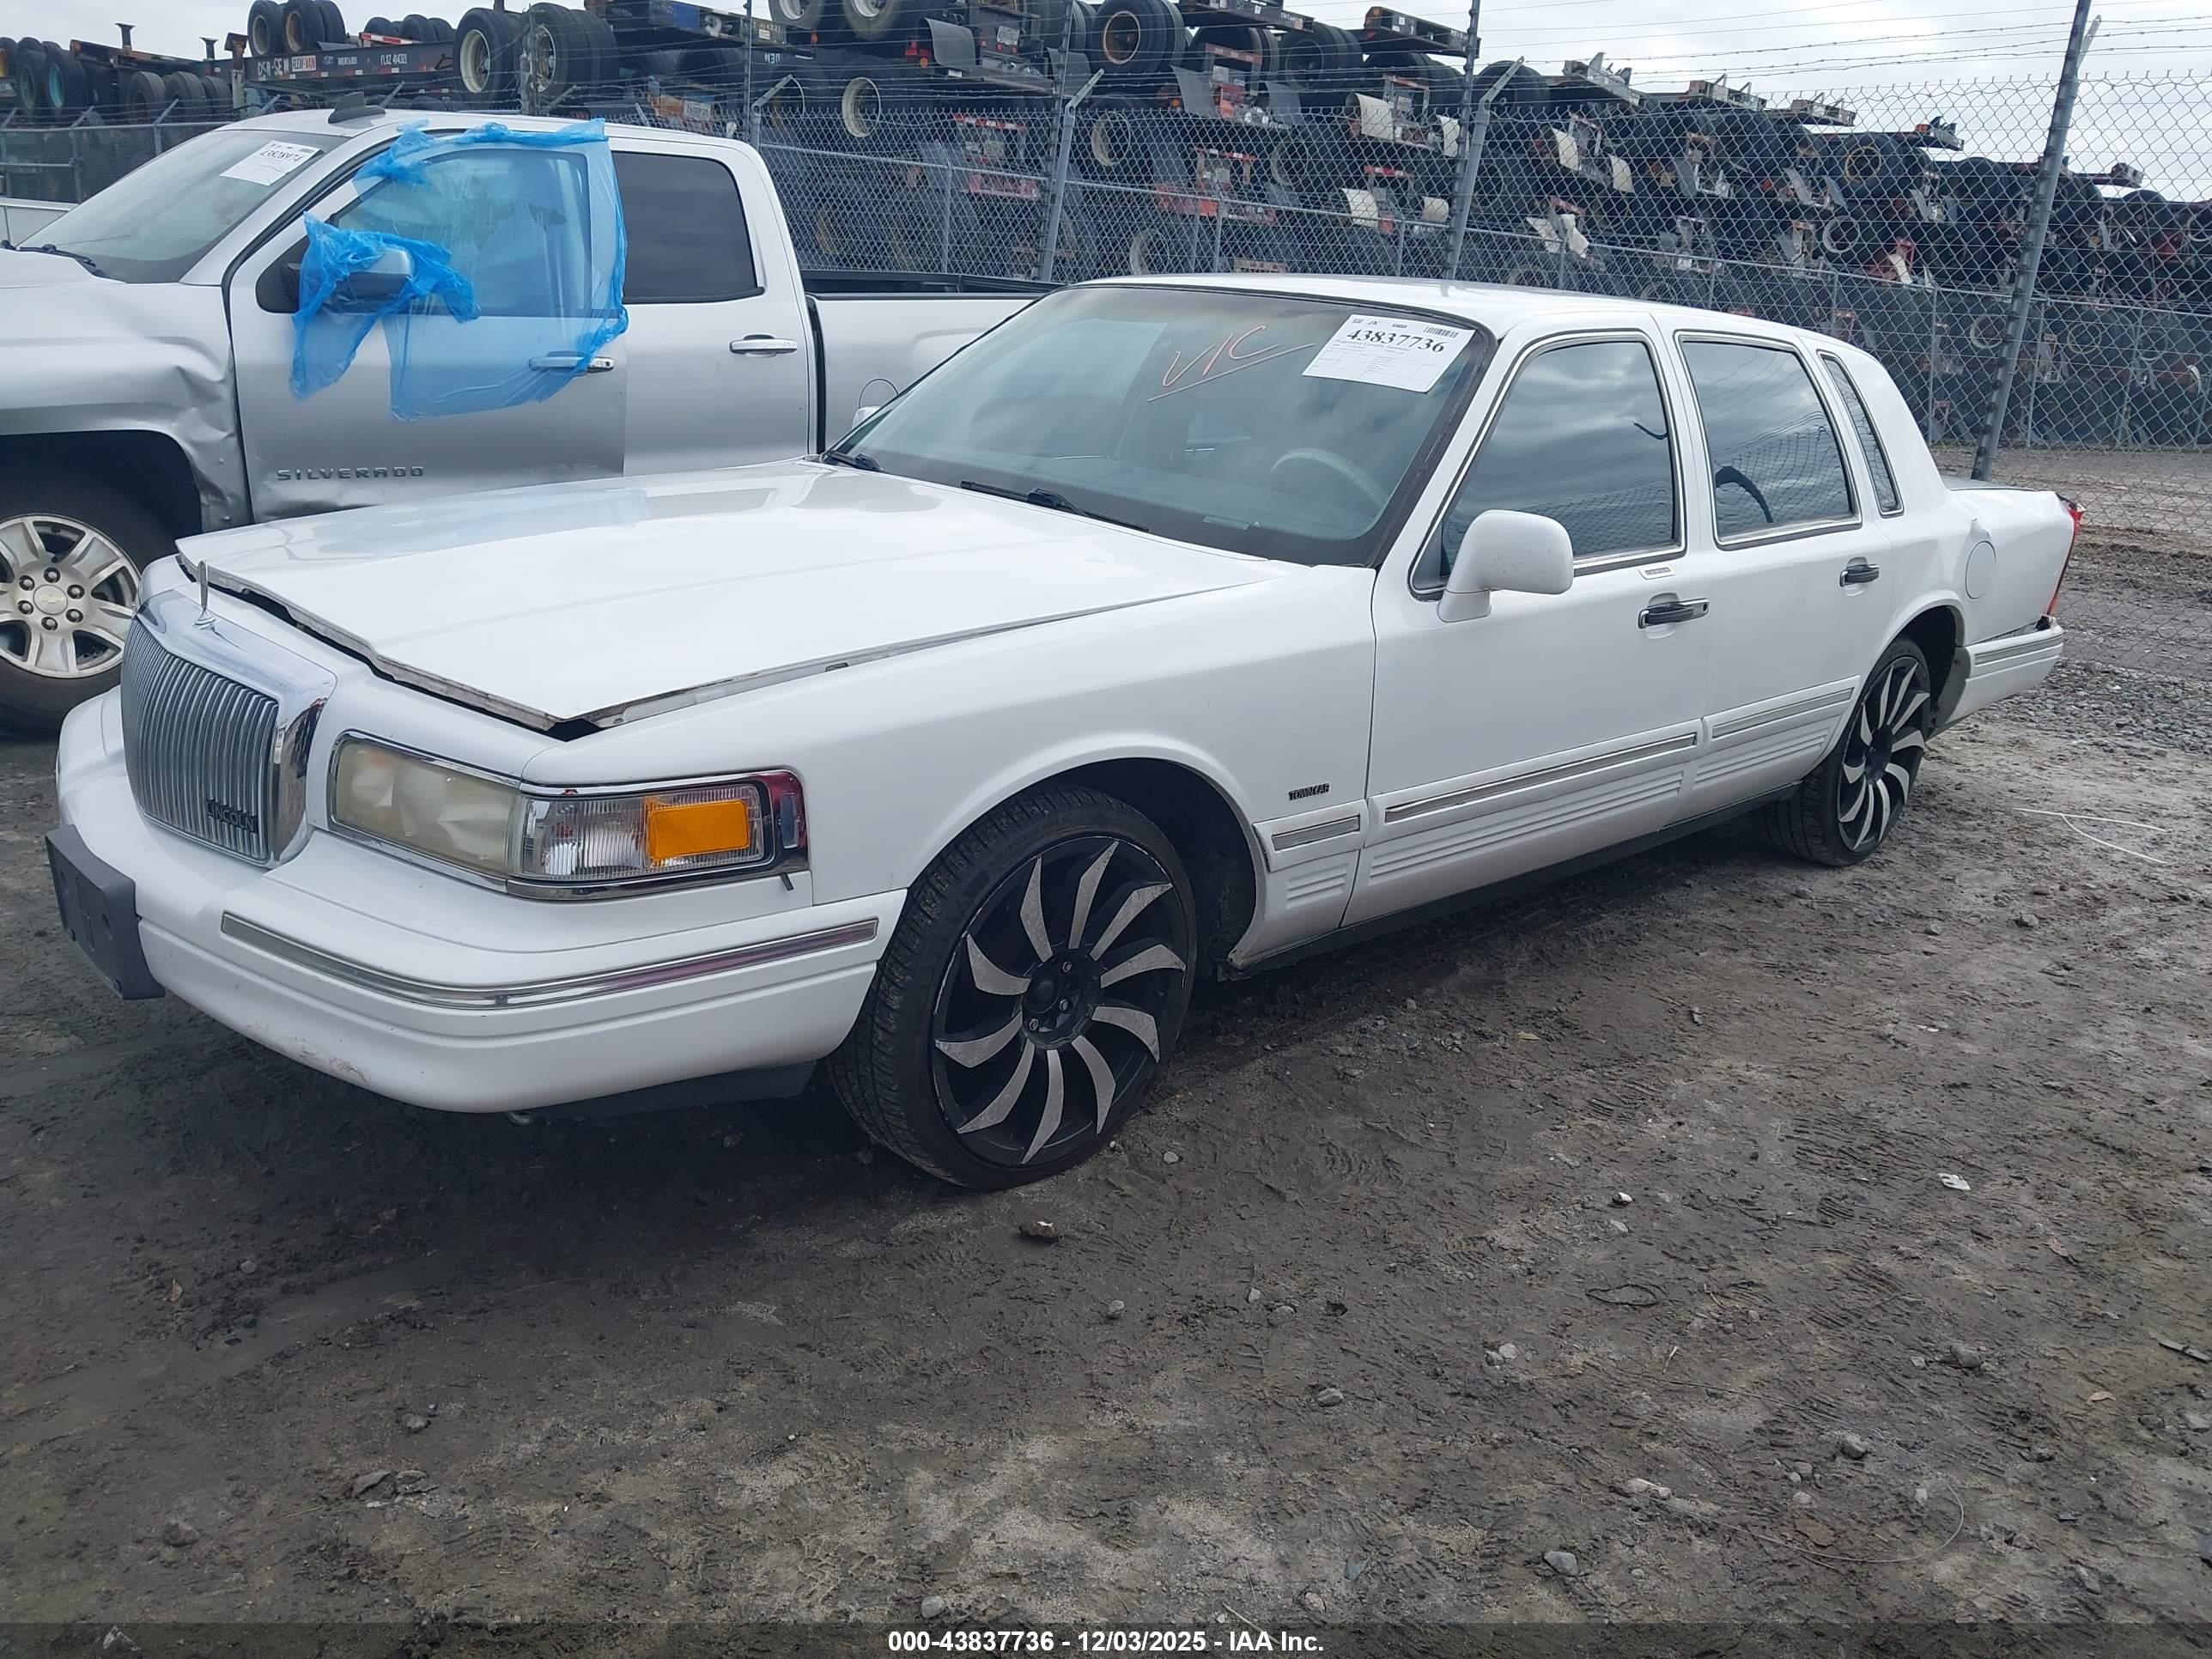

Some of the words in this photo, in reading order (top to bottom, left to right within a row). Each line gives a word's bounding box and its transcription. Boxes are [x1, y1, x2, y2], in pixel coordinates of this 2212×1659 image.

[1347, 329, 1449, 353] 43837736
[276, 466, 424, 481] SILVERADO
[206, 802, 255, 832] LINCOLN
